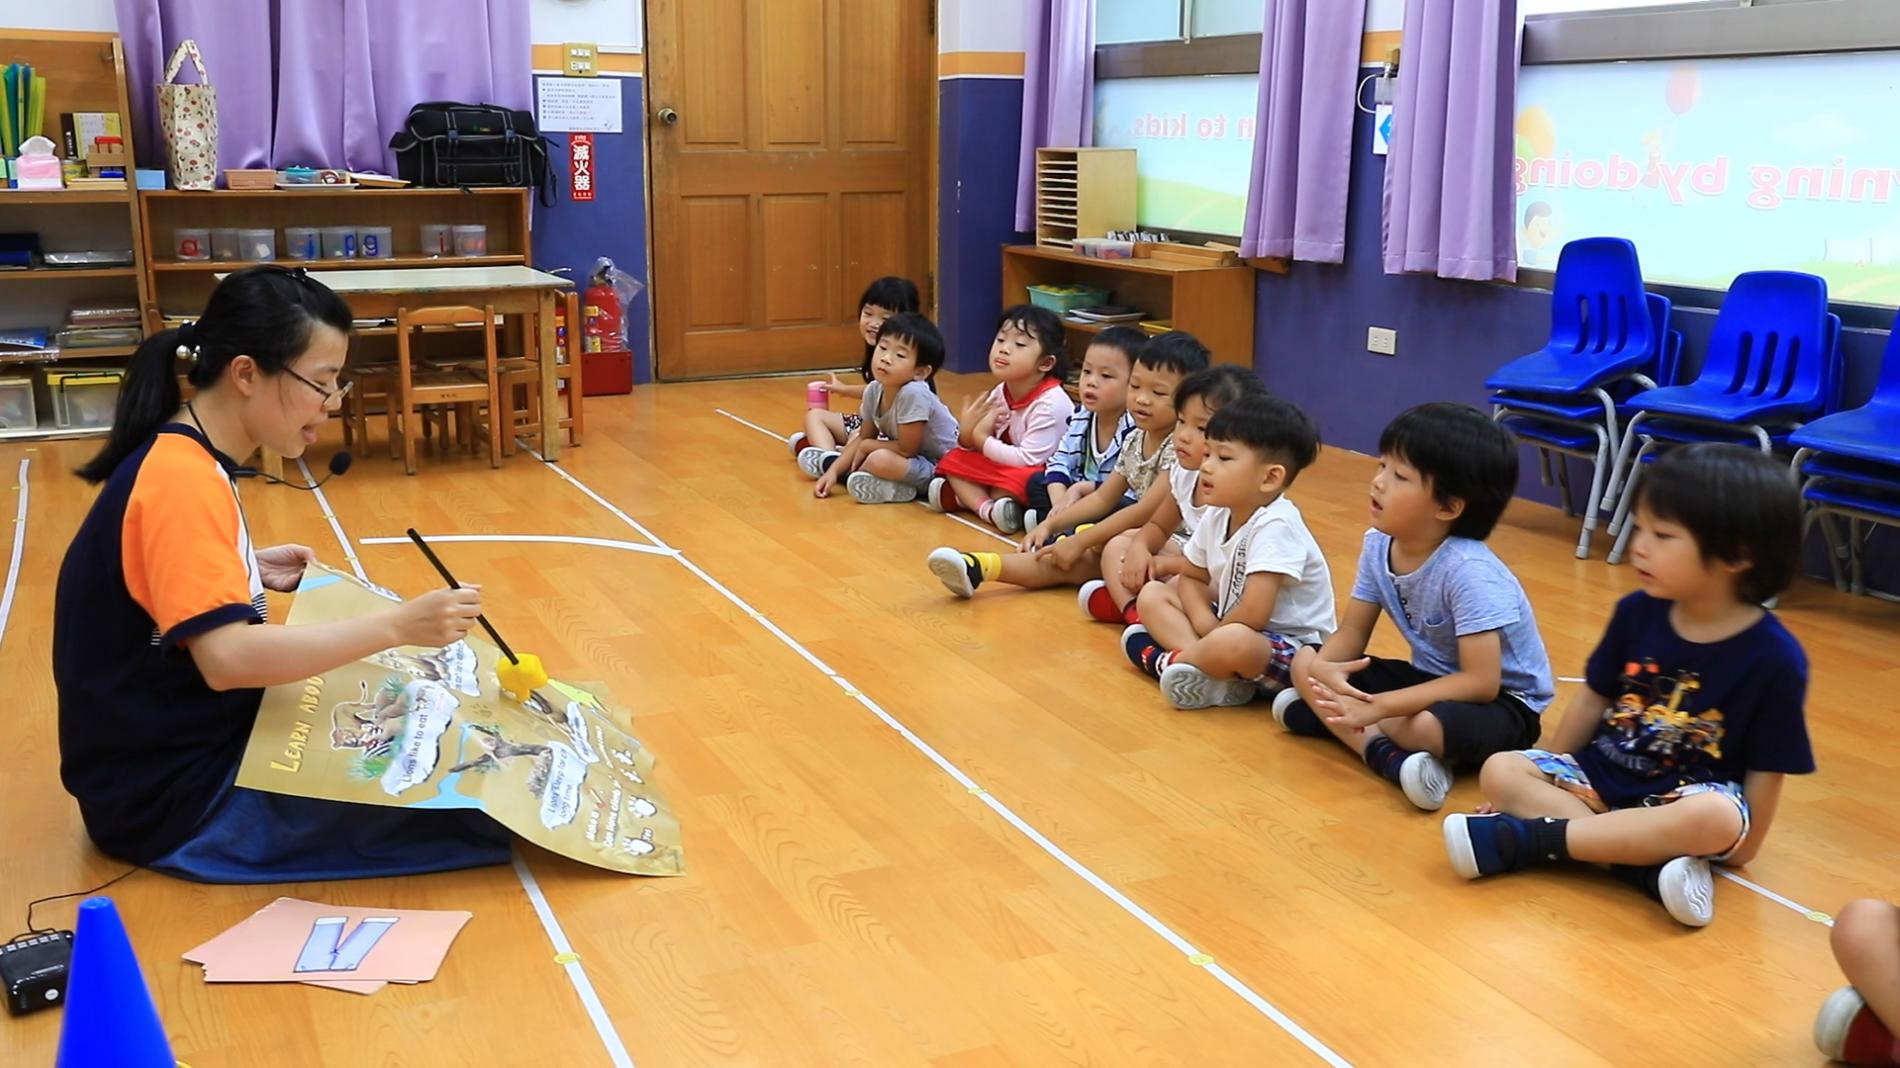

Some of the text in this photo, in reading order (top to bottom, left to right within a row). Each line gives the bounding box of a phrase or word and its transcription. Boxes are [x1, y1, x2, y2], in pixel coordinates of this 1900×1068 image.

[573, 145, 590, 190] 滅火器
[364, 234, 378, 256] g
[270, 676, 324, 773] LEARN ABOU
[418, 714, 428, 728] eat
[414, 730, 424, 743] to
[410, 744, 421, 760] like
[402, 758, 417, 782] Lions
